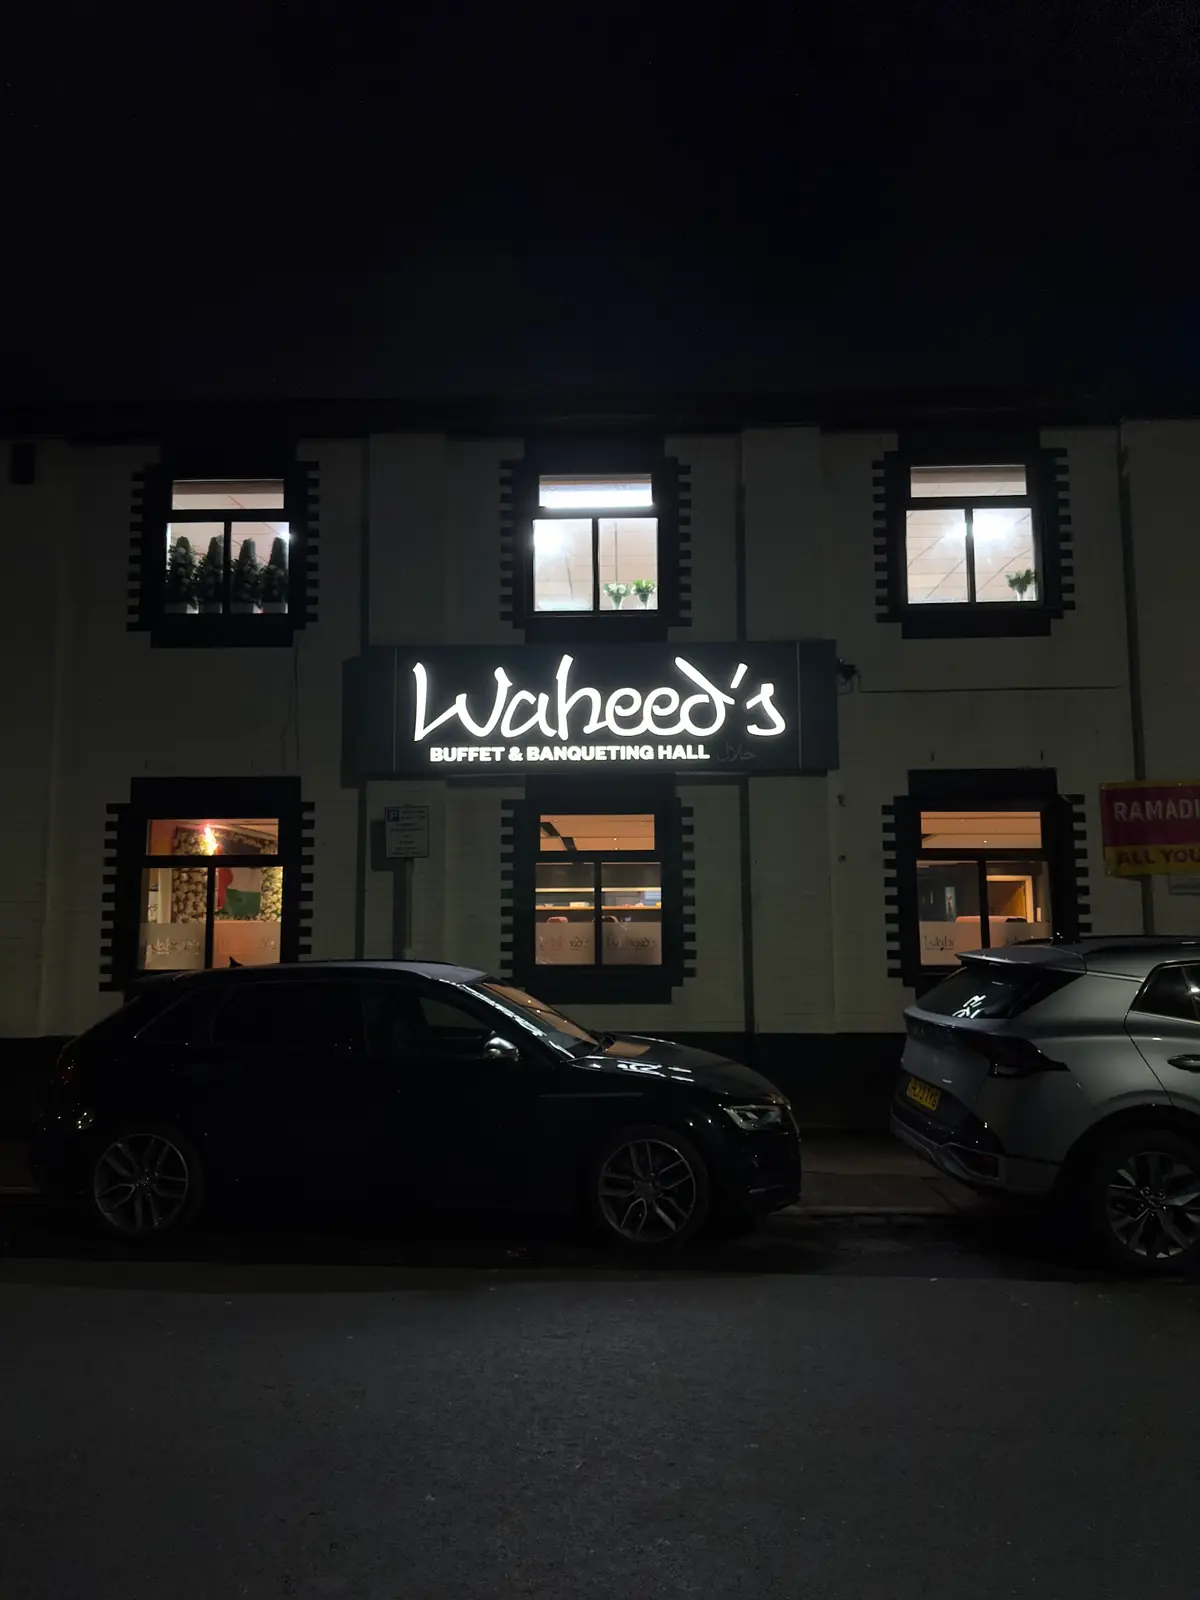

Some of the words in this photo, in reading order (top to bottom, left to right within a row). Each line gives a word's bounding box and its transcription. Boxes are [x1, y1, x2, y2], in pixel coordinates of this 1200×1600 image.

[412, 654, 786, 741] Waheed's
[430, 746, 505, 763] BUFFET
[508, 746, 524, 762] &
[526, 745, 654, 762] BANQUETING
[657, 744, 710, 761] HALL
[1117, 850, 1156, 866] ALL
